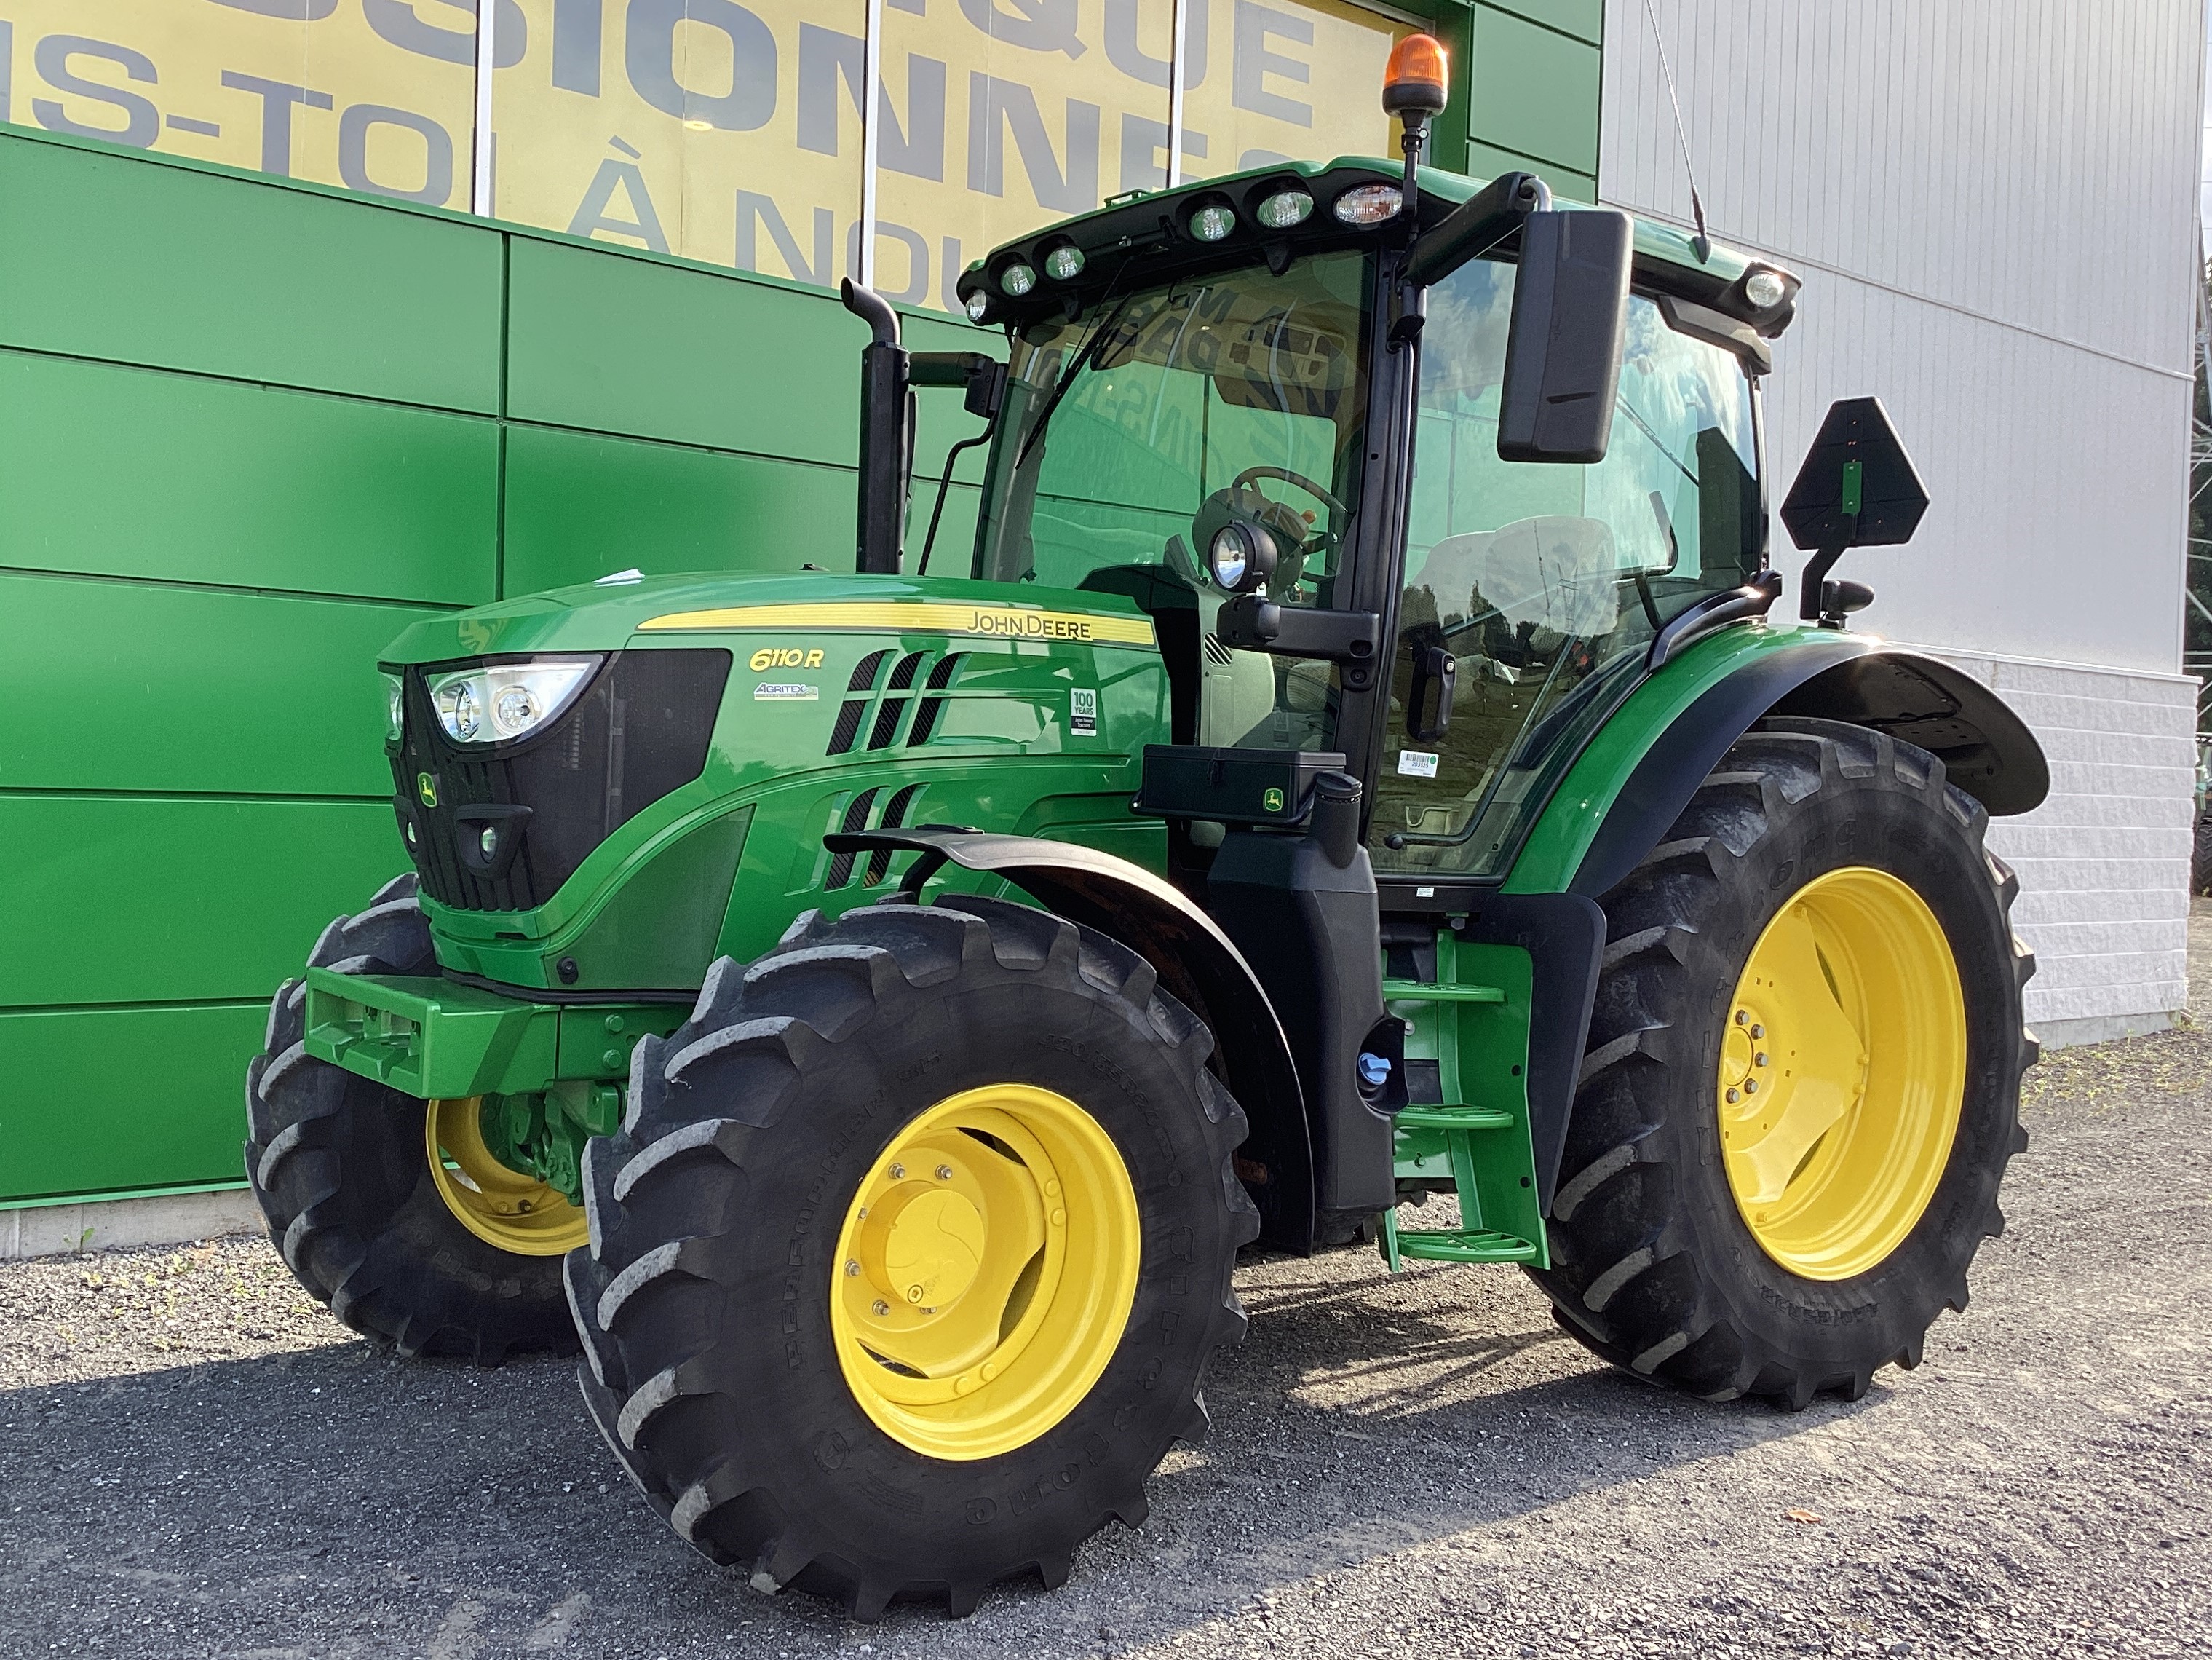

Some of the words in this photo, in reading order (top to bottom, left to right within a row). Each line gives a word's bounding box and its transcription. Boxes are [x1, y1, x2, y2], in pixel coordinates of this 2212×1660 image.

[887, 0, 1314, 128] QUE
[566, 135, 671, 255] À
[967, 611, 1023, 633] JOHN
[1027, 614, 1091, 639] DEERE
[756, 684, 805, 693] AGRITEX
[1074, 692, 1093, 707] 100
[1074, 706, 1093, 715] YEARS
